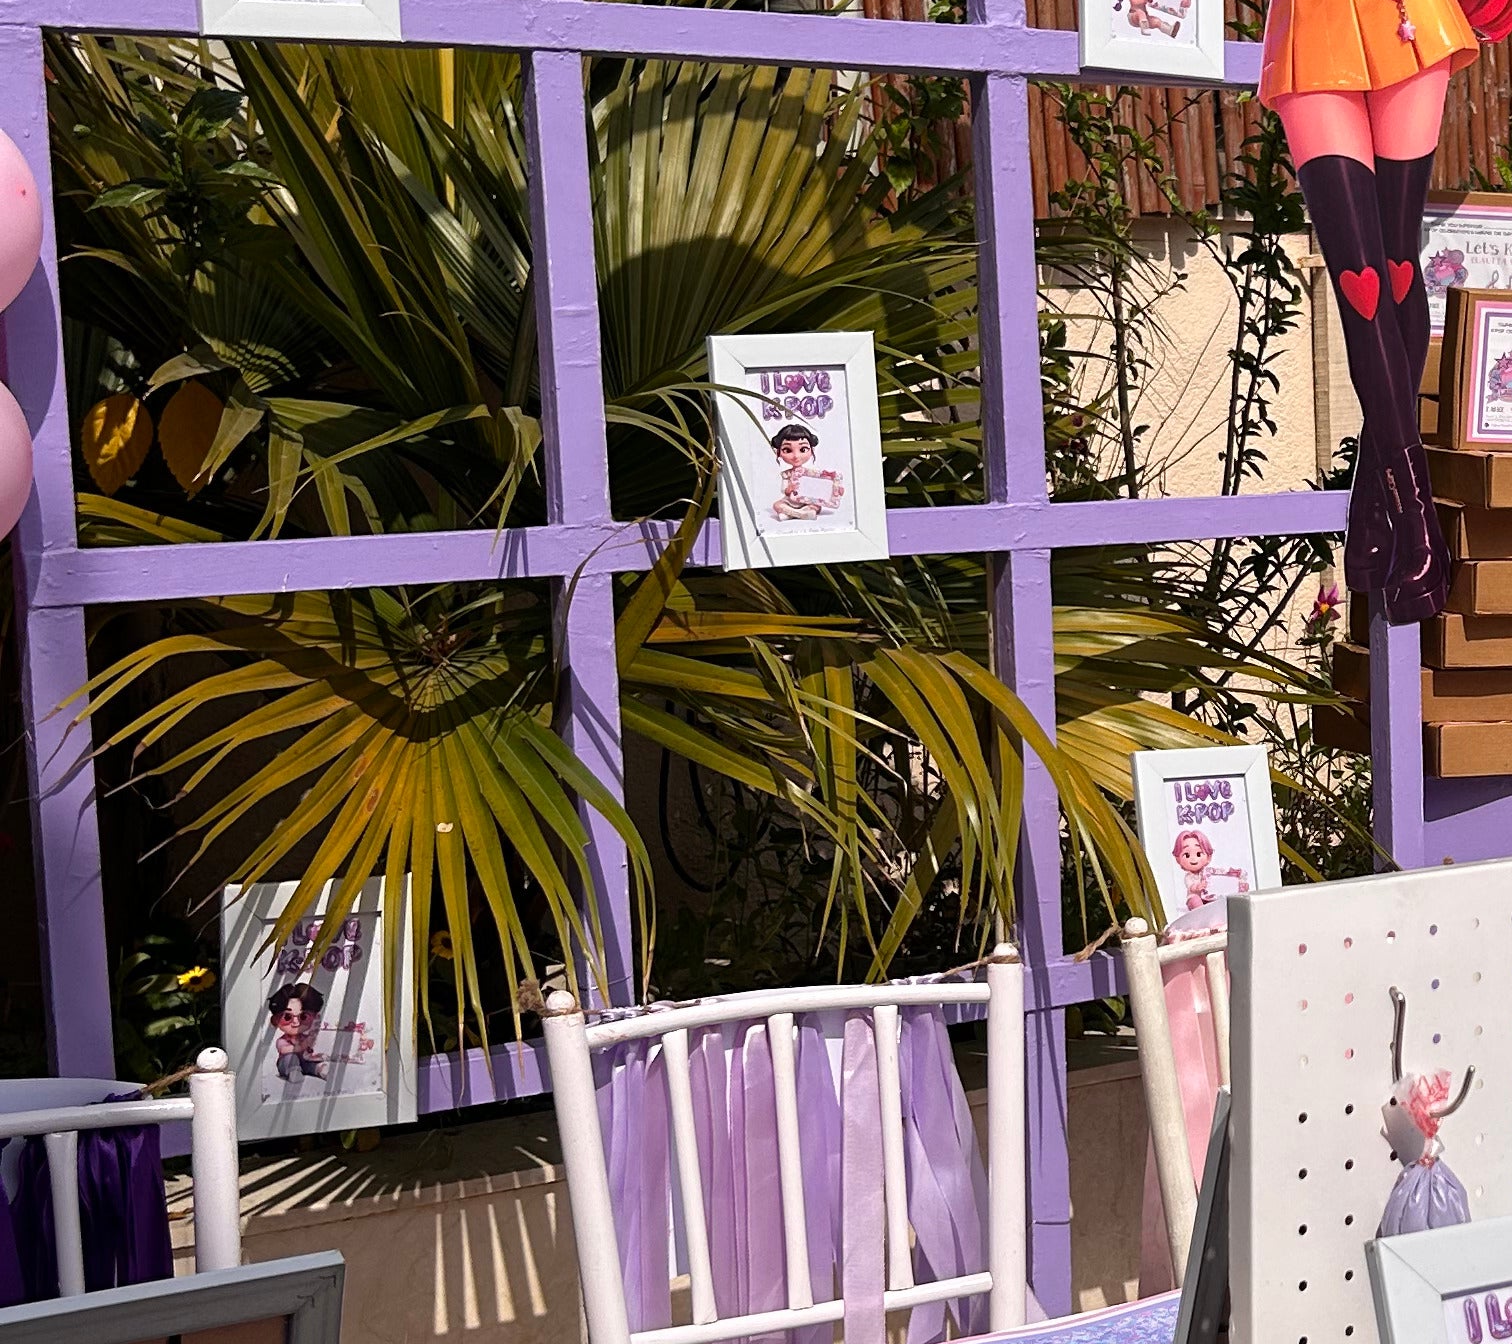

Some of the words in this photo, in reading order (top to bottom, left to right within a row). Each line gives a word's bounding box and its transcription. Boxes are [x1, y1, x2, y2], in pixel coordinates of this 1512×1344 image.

[1465, 240, 1500, 256] Let's
[760, 372, 770, 395] I
[1174, 781, 1182, 803] I
[1463, 1296, 1483, 1344] I
